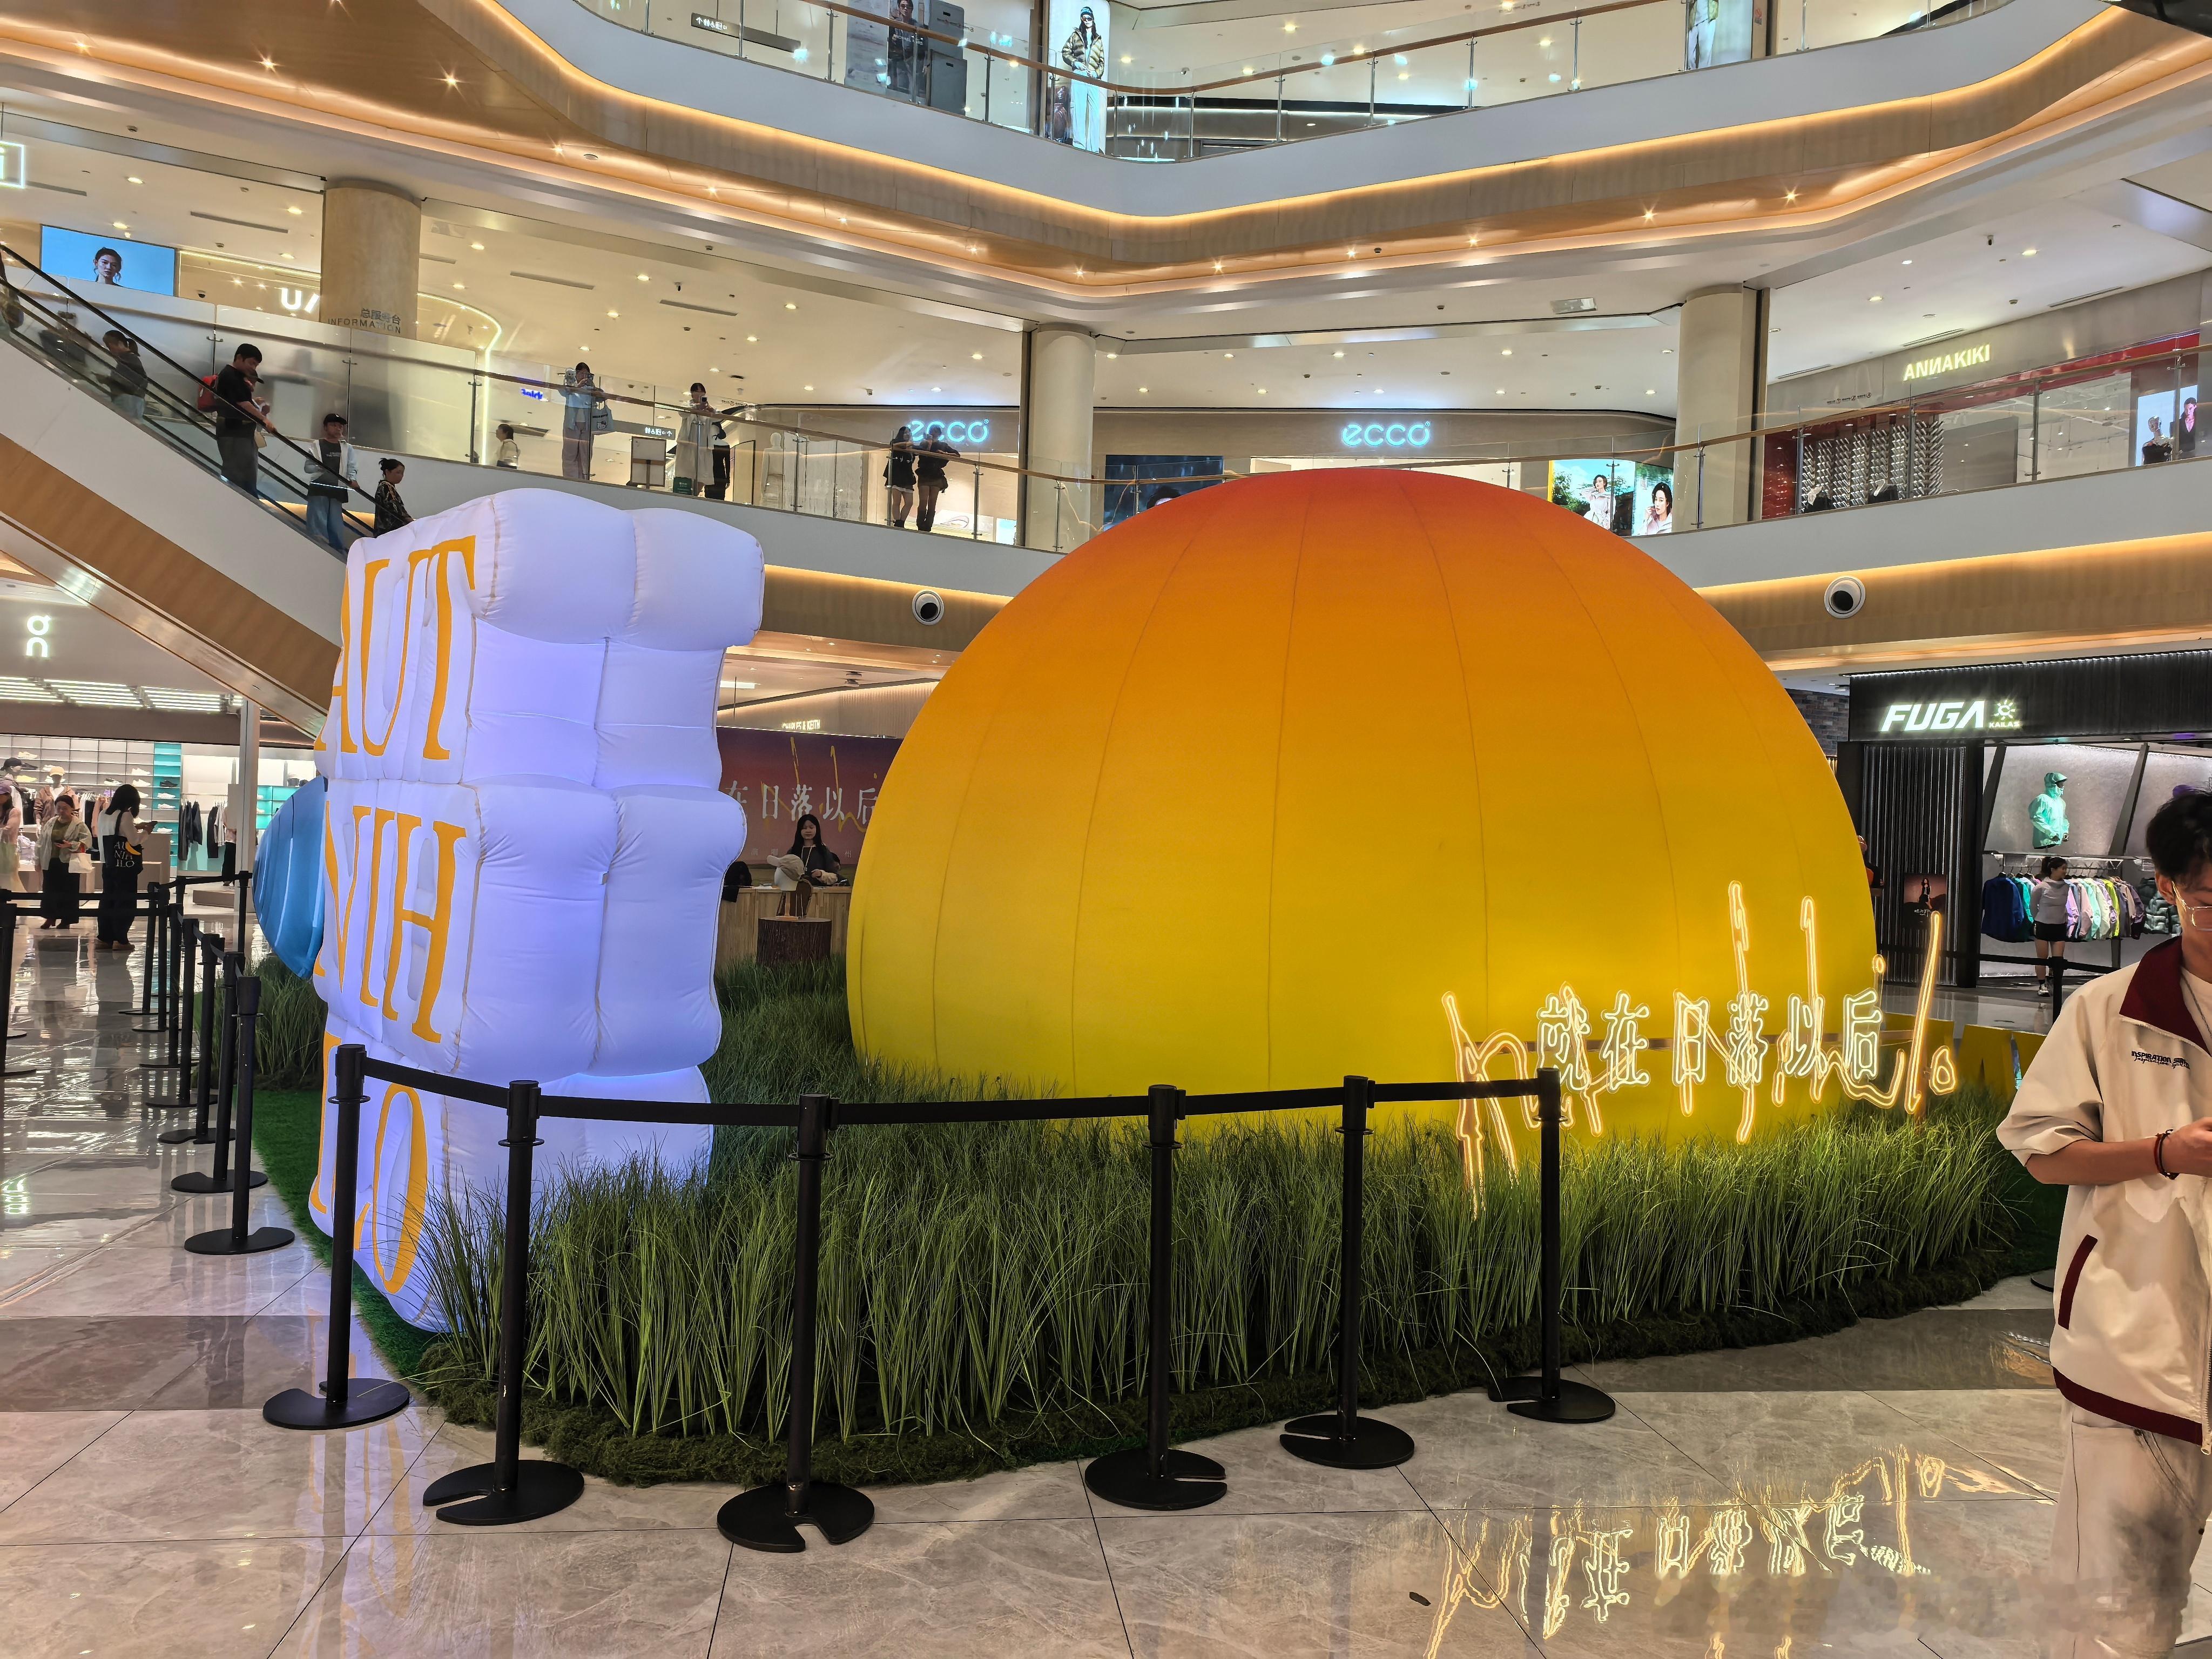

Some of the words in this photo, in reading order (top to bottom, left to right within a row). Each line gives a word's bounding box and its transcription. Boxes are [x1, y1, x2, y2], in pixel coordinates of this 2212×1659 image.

[328, 318, 401, 334] INFORMATION
[360, 308, 401, 325] 总服务台
[1342, 424, 1430, 446] ecco
[807, 719, 820, 730] KEITH
[1880, 700, 1985, 732] FUGA
[1537, 987, 1883, 1093] 就在日落以后
